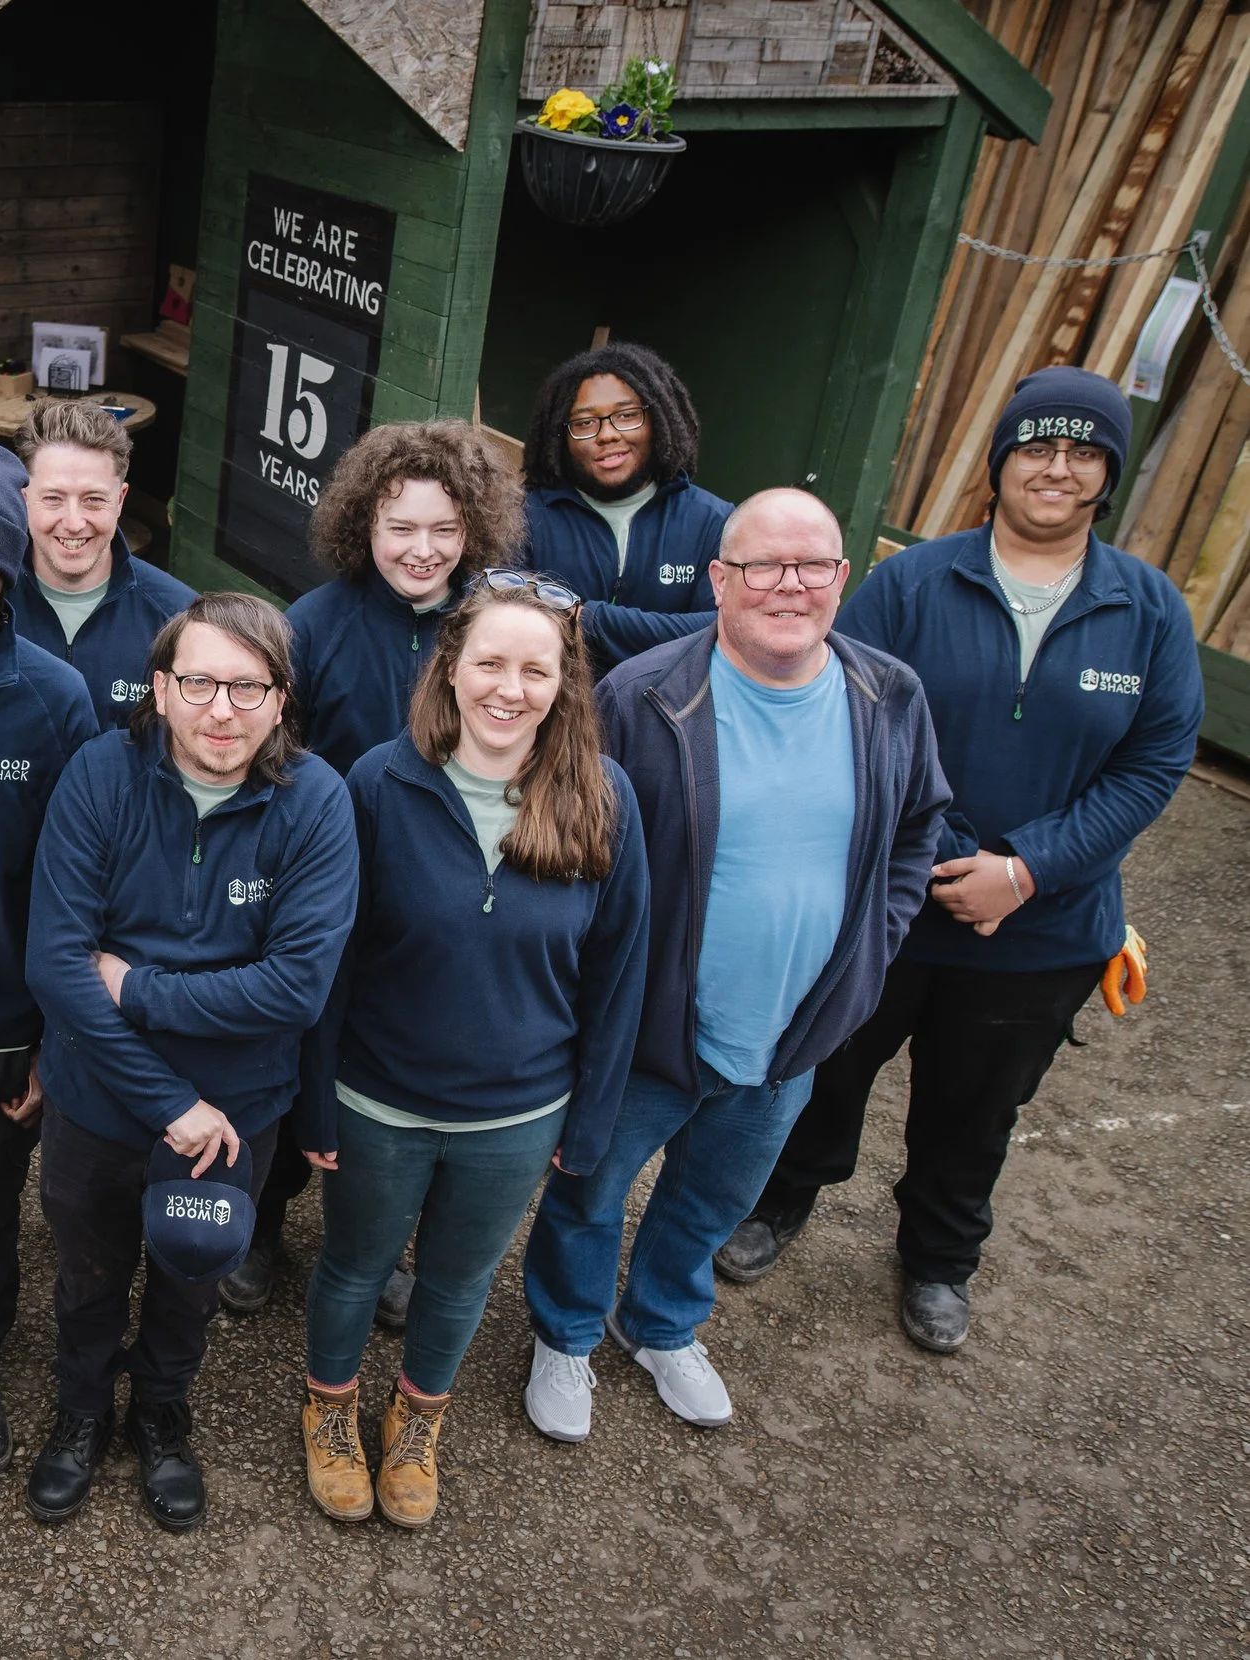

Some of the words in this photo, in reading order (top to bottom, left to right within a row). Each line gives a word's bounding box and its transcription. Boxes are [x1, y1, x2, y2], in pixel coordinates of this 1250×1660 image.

[274, 206, 304, 244] WE
[312, 220, 359, 262] ARE
[247, 240, 383, 316] CELEBRATING
[259, 343, 335, 460] 15
[1039, 416, 1095, 431] WOOD
[1036, 426, 1091, 441] SHACK
[259, 449, 320, 507] YEARS
[675, 565, 695, 575] WO
[1100, 671, 1141, 686] WOOD
[130, 682, 150, 693] WO
[1099, 681, 1140, 695] SHACK
[247, 878, 273, 893] WOO
[166, 1195, 213, 1210] SHACK
[166, 1206, 211, 1222] WOOD
